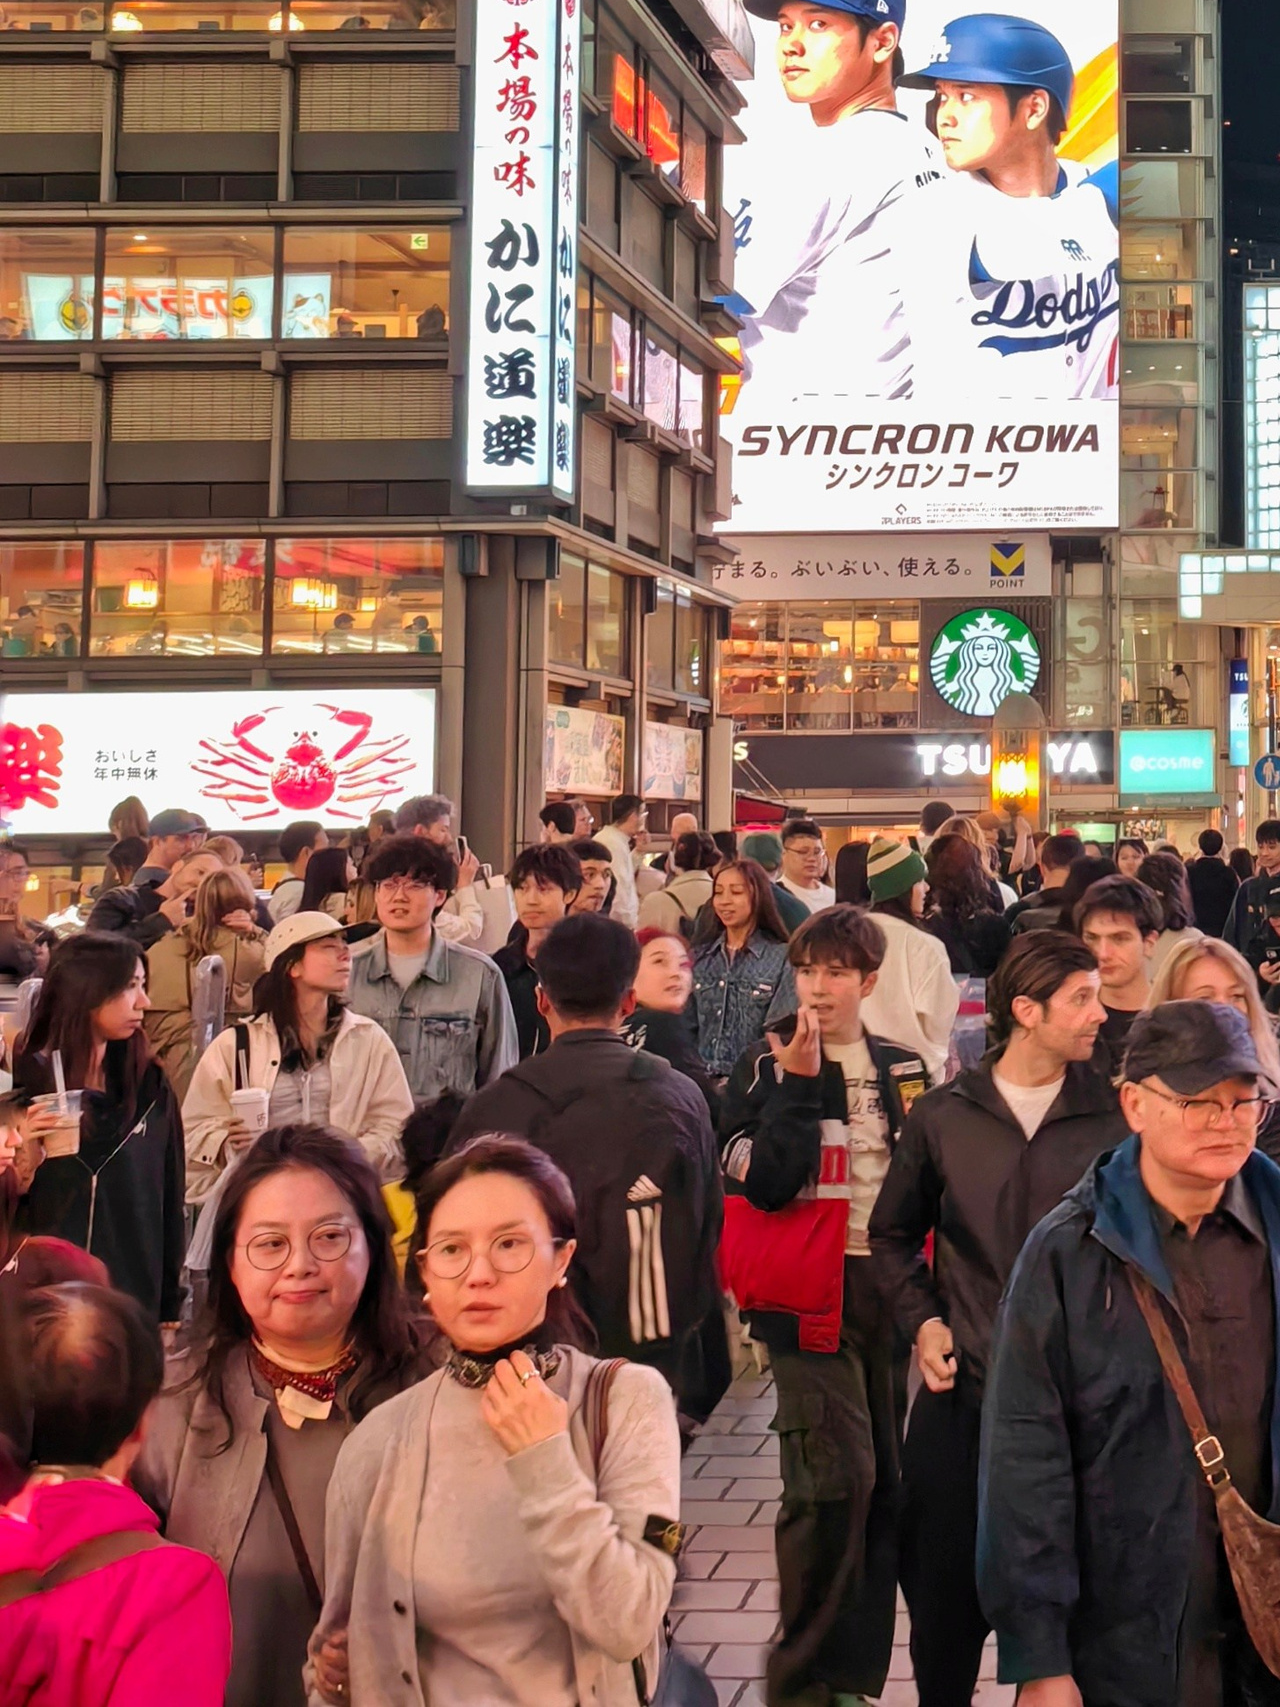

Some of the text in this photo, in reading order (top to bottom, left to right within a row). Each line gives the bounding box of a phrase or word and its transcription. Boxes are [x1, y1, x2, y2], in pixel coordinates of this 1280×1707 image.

[493, 21, 539, 197] 本場の味
[737, 423, 1100, 457] SYNCRON KOWA
[989, 578, 1026, 589] POINT
[95, 749, 158, 763] おいしさ
[917, 741, 1098, 776] TSUYA
[1129, 754, 1204, 772] @cosme
[93, 766, 159, 781] 年中無休
